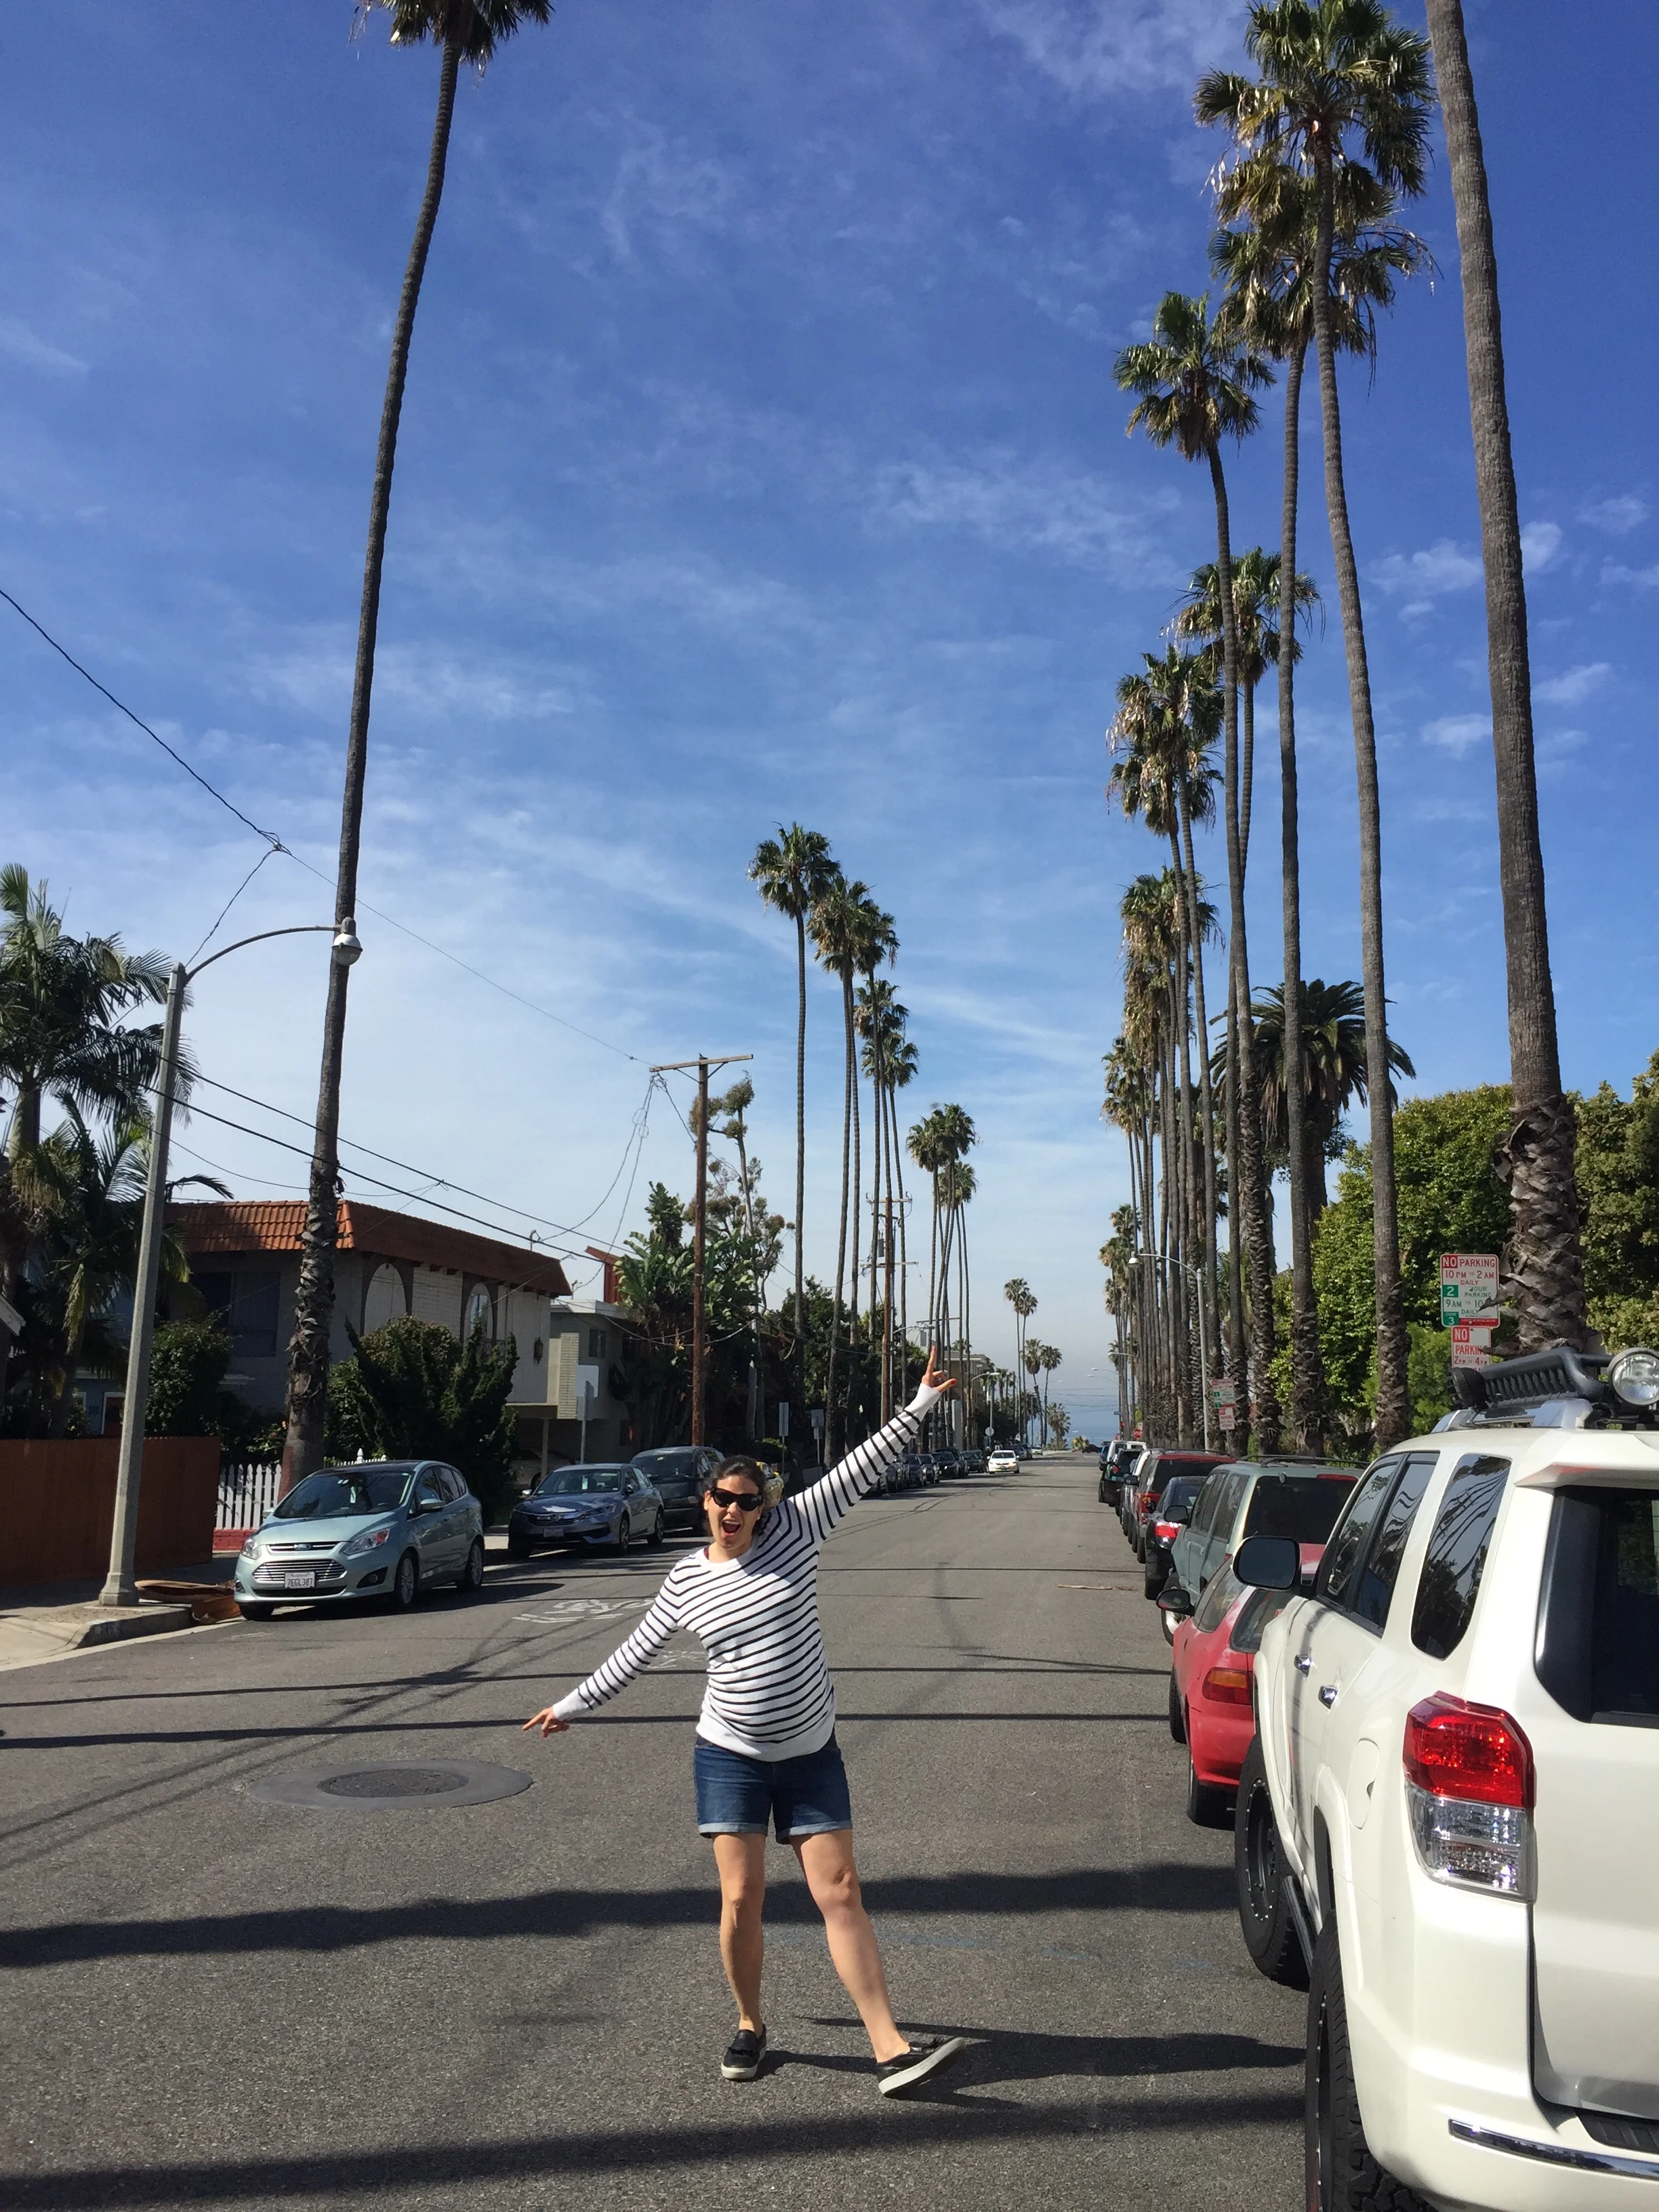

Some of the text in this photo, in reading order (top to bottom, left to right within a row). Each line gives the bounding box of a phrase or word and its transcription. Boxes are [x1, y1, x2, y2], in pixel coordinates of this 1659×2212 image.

[1443, 1256, 1495, 1267] NO PARKING
[1445, 1270, 1454, 1278] 10
[1477, 1270, 1482, 1279] 2
[1447, 1286, 1455, 1296] 2
[1448, 1317, 1455, 1326] 3
[1454, 1328, 1468, 1341] NO
